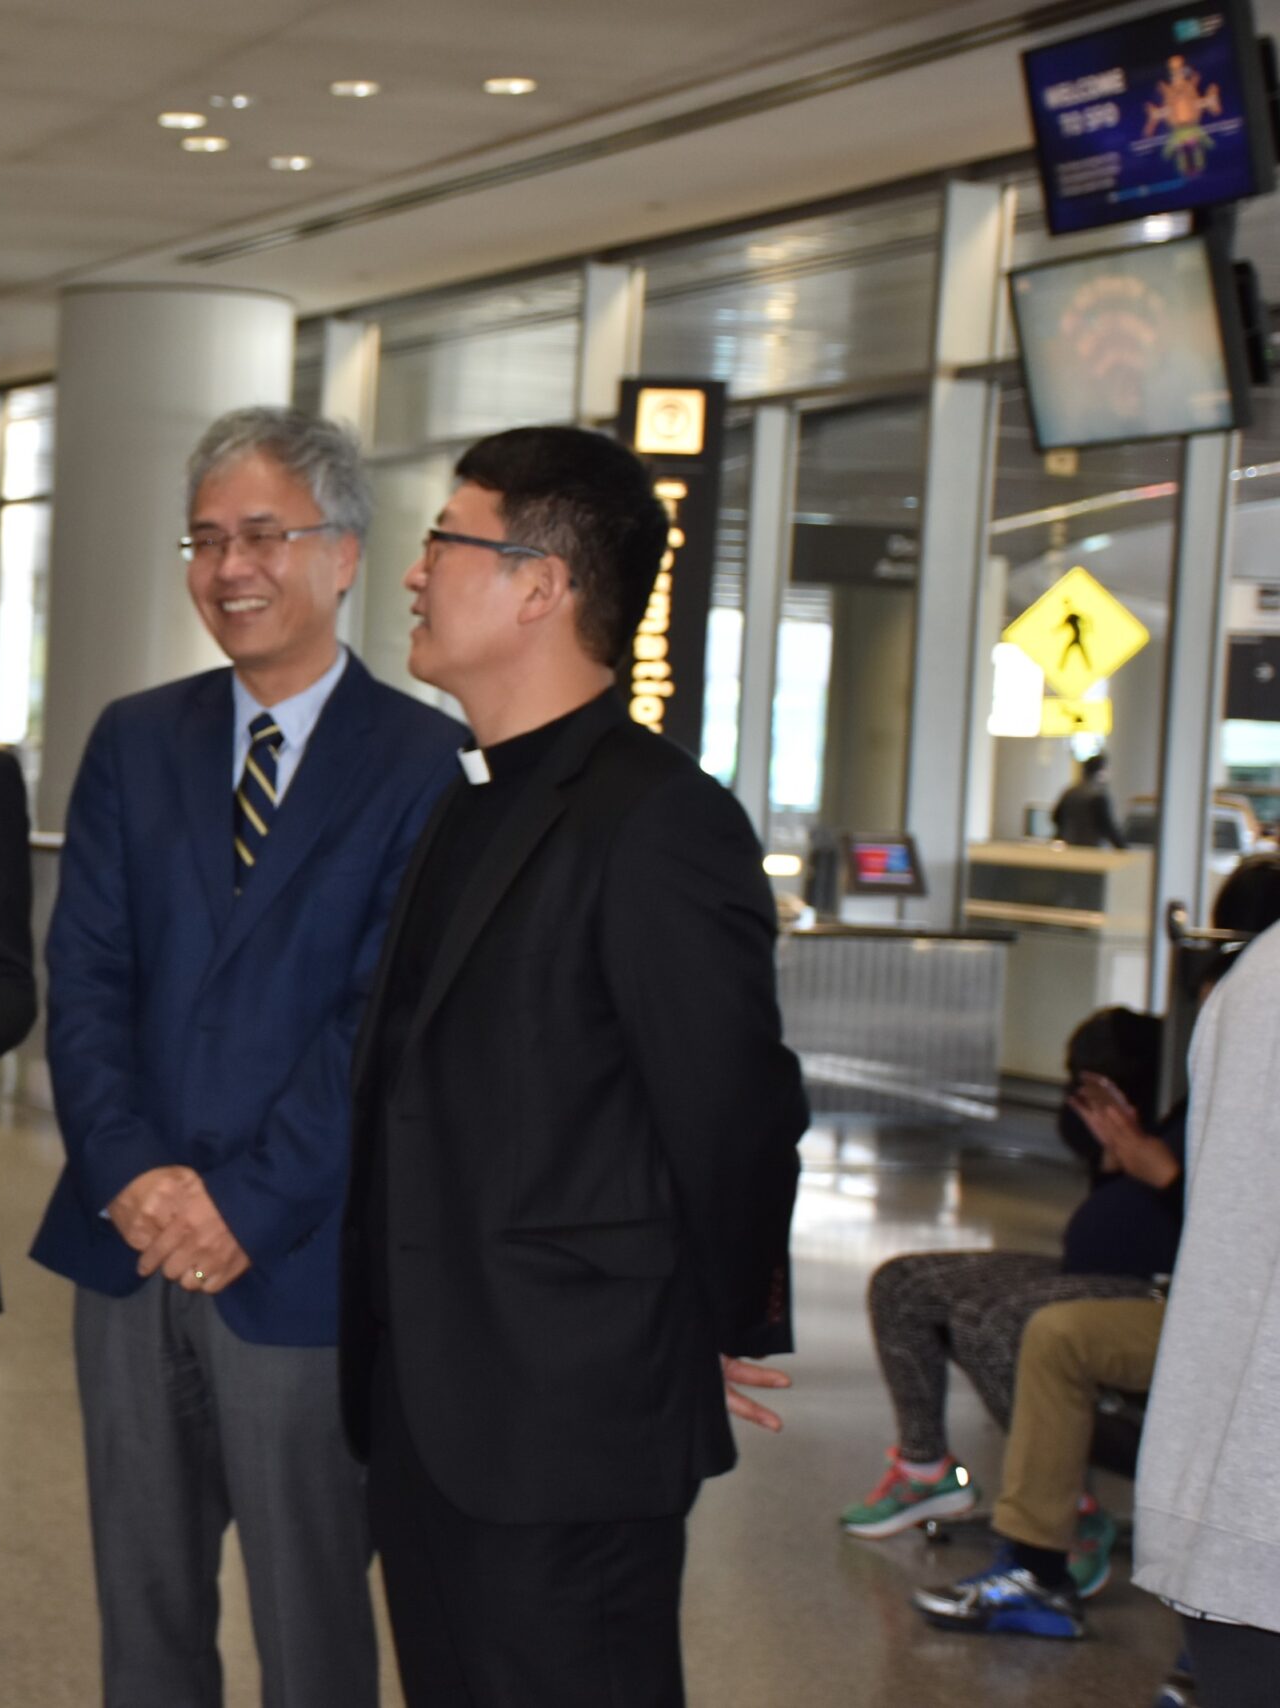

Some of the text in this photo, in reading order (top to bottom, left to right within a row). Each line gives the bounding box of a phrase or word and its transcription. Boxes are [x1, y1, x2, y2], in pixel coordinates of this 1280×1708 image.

[1043, 67, 1126, 109] WELCOME
[1058, 110, 1084, 137] TO
[629, 480, 688, 734] Imatio
